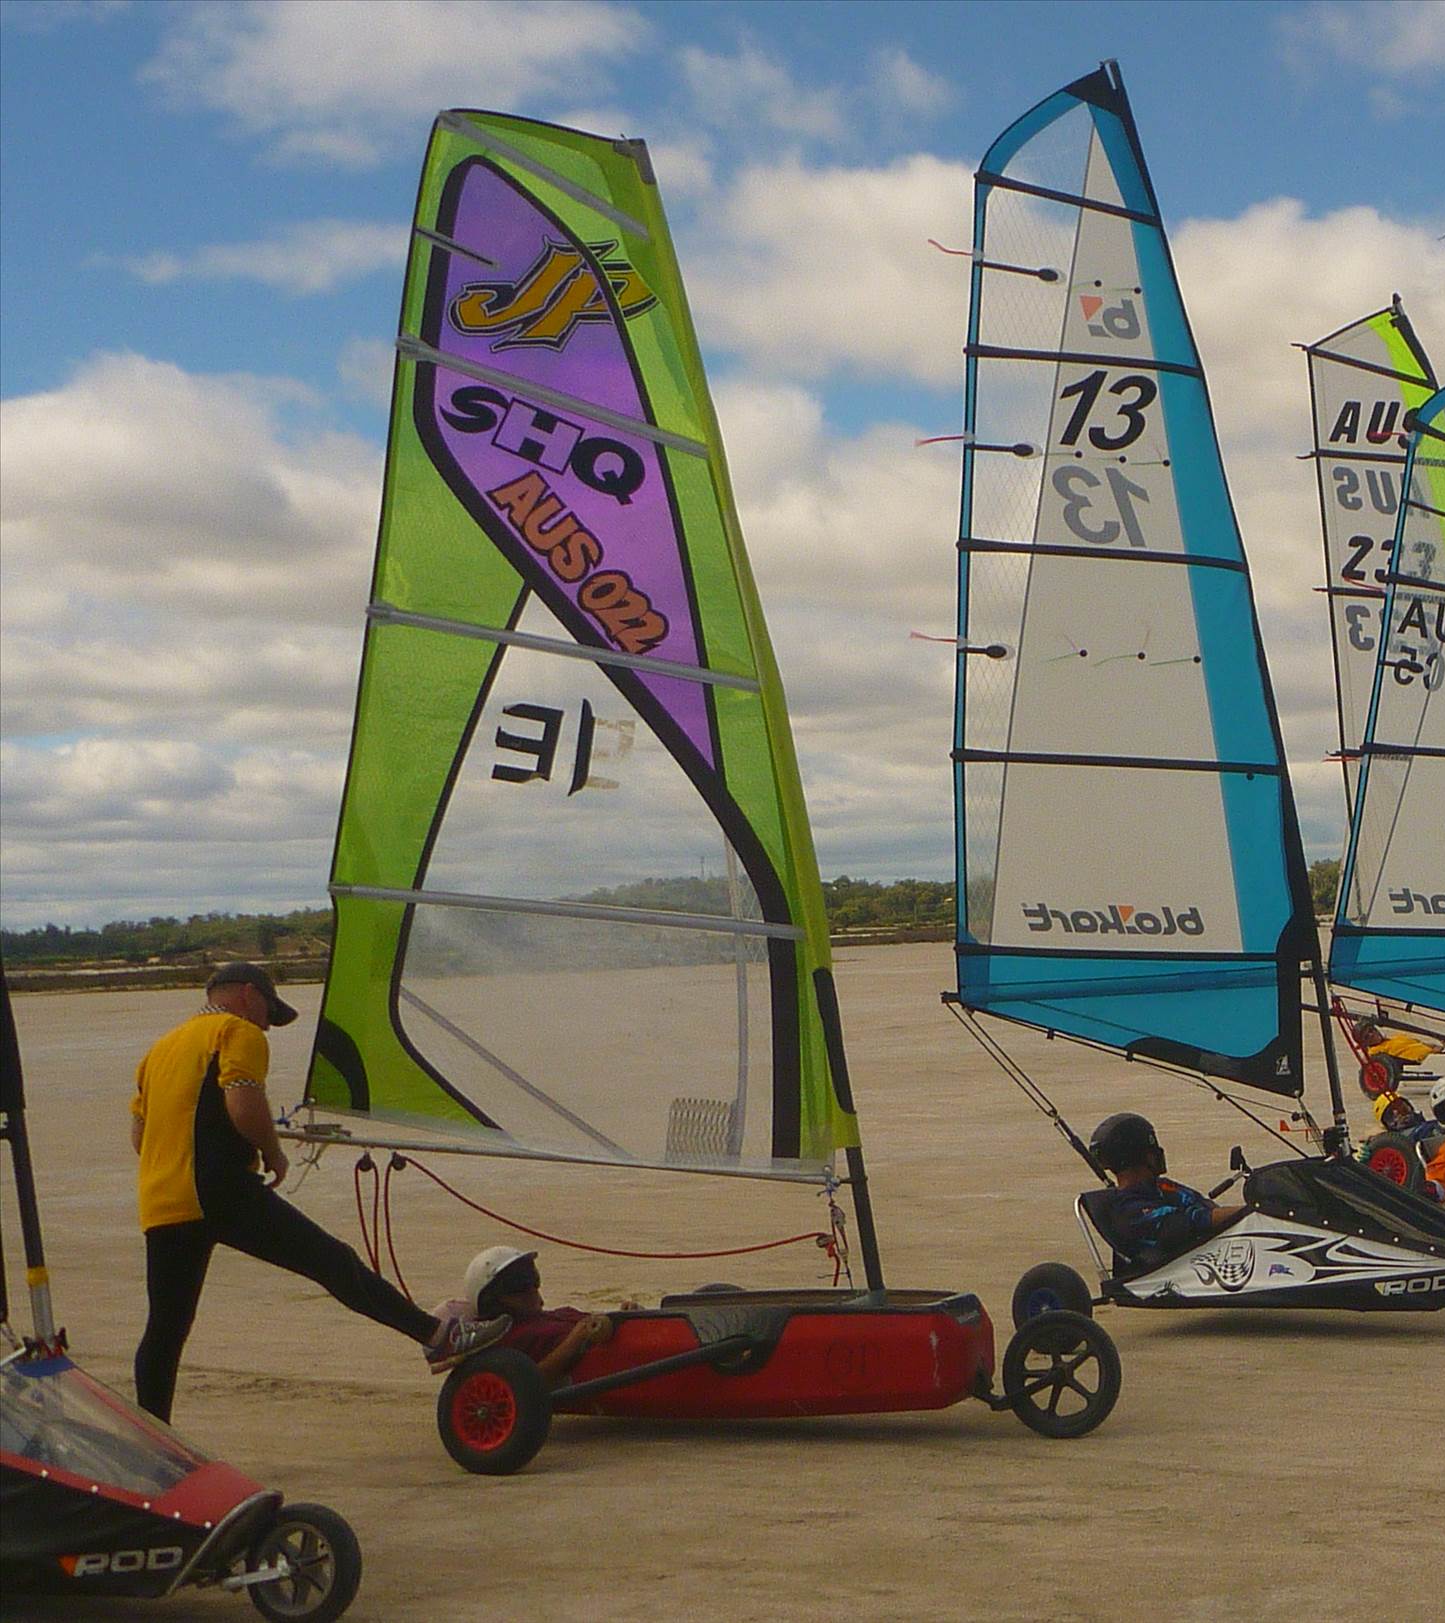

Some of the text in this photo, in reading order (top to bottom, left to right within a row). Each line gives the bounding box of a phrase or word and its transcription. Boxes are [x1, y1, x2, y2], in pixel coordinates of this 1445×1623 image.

[449, 236, 662, 353] JP
[439, 385, 646, 505] SHQ
[1060, 370, 1157, 451] 13
[1328, 400, 1419, 450] AU
[486, 470, 670, 655] AUS 022
[74, 1546, 183, 1577] POD
